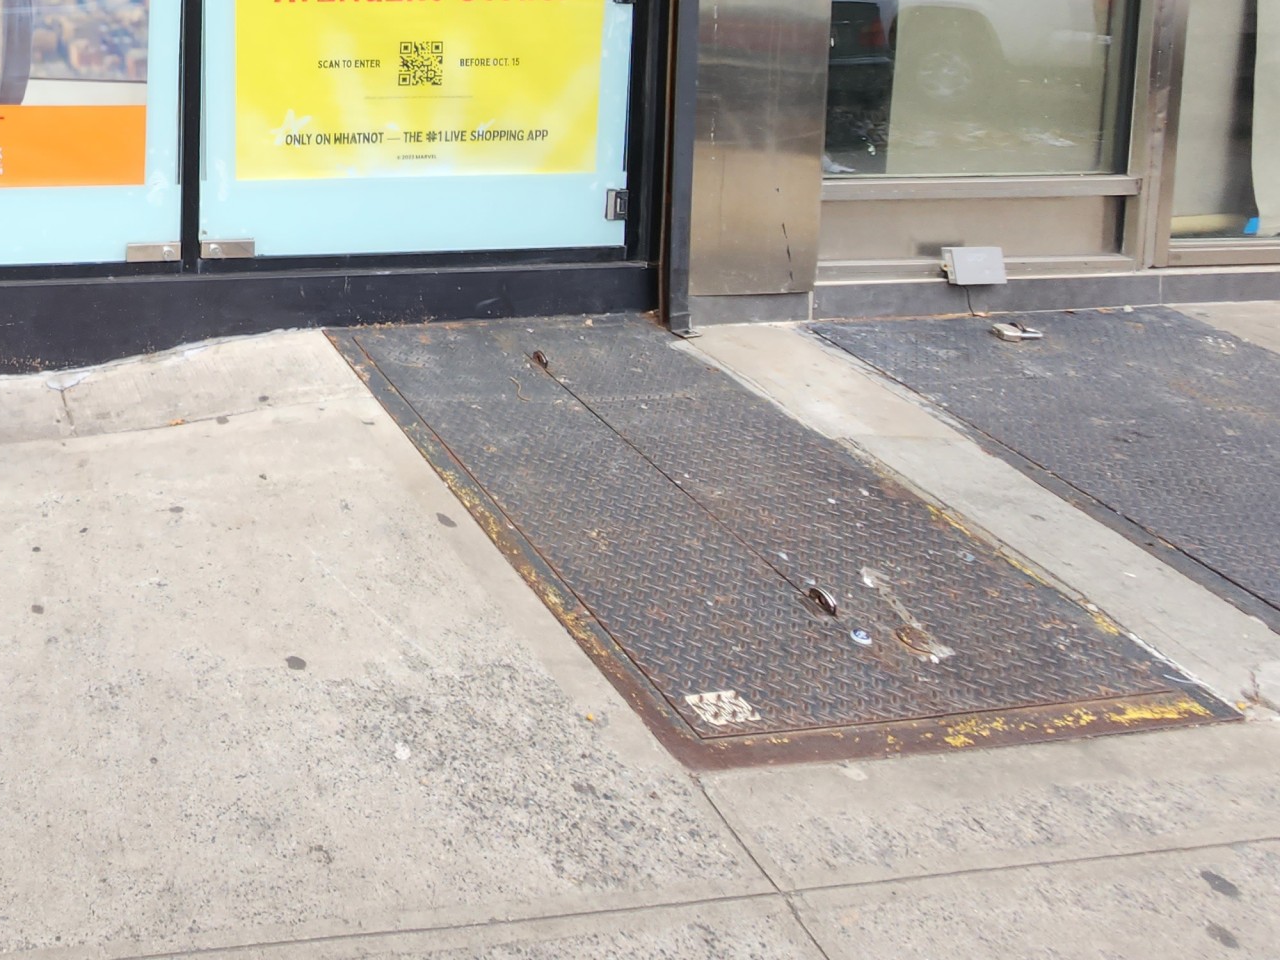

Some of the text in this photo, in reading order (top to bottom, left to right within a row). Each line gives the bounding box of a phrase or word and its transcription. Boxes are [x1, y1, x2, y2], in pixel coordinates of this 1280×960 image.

[317, 59, 381, 69] SCAN TO ENTER
[459, 58, 520, 67] BEFORE OCT. 15
[285, 134, 312, 146] ONLY
[315, 133, 331, 145] ON
[333, 132, 384, 144] WHATNOT
[403, 131, 423, 143] THE
[470, 130, 524, 142] SHOPPING
[526, 129, 549, 141] APP
